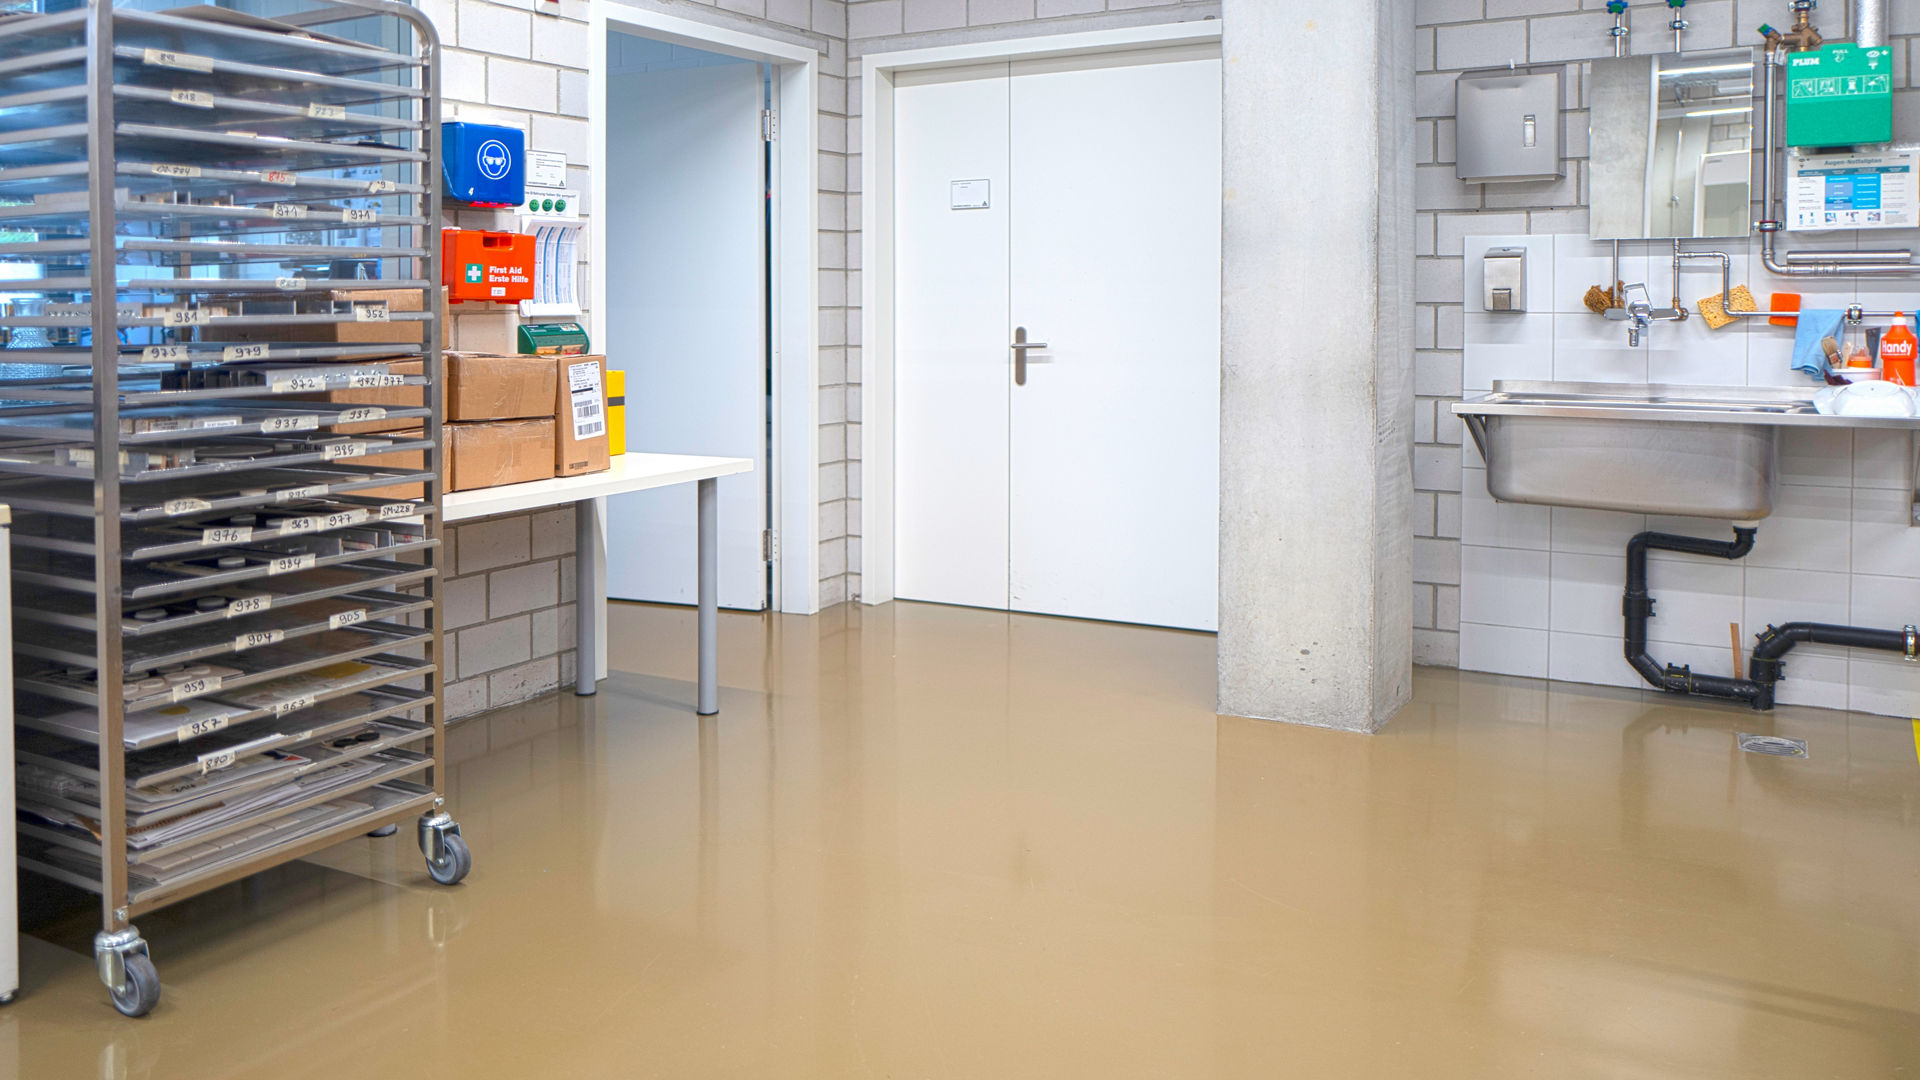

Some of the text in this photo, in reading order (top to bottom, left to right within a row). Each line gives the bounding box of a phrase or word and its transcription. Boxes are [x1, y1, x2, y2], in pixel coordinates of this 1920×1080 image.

[1792, 57, 1819, 67] PLUM
[468, 186, 475, 196] 4
[489, 266, 522, 275] First Aid
[488, 275, 529, 284] Erste Hilfe
[235, 346, 261, 358] 979
[1881, 340, 1912, 356] Handy
[290, 378, 315, 390] 972
[274, 418, 299, 429] 937
[329, 511, 352, 527] 977
[212, 529, 239, 542] 976
[234, 599, 260, 612] 978
[338, 611, 360, 625] 905
[184, 679, 205, 694] 959
[192, 718, 222, 735] 957
